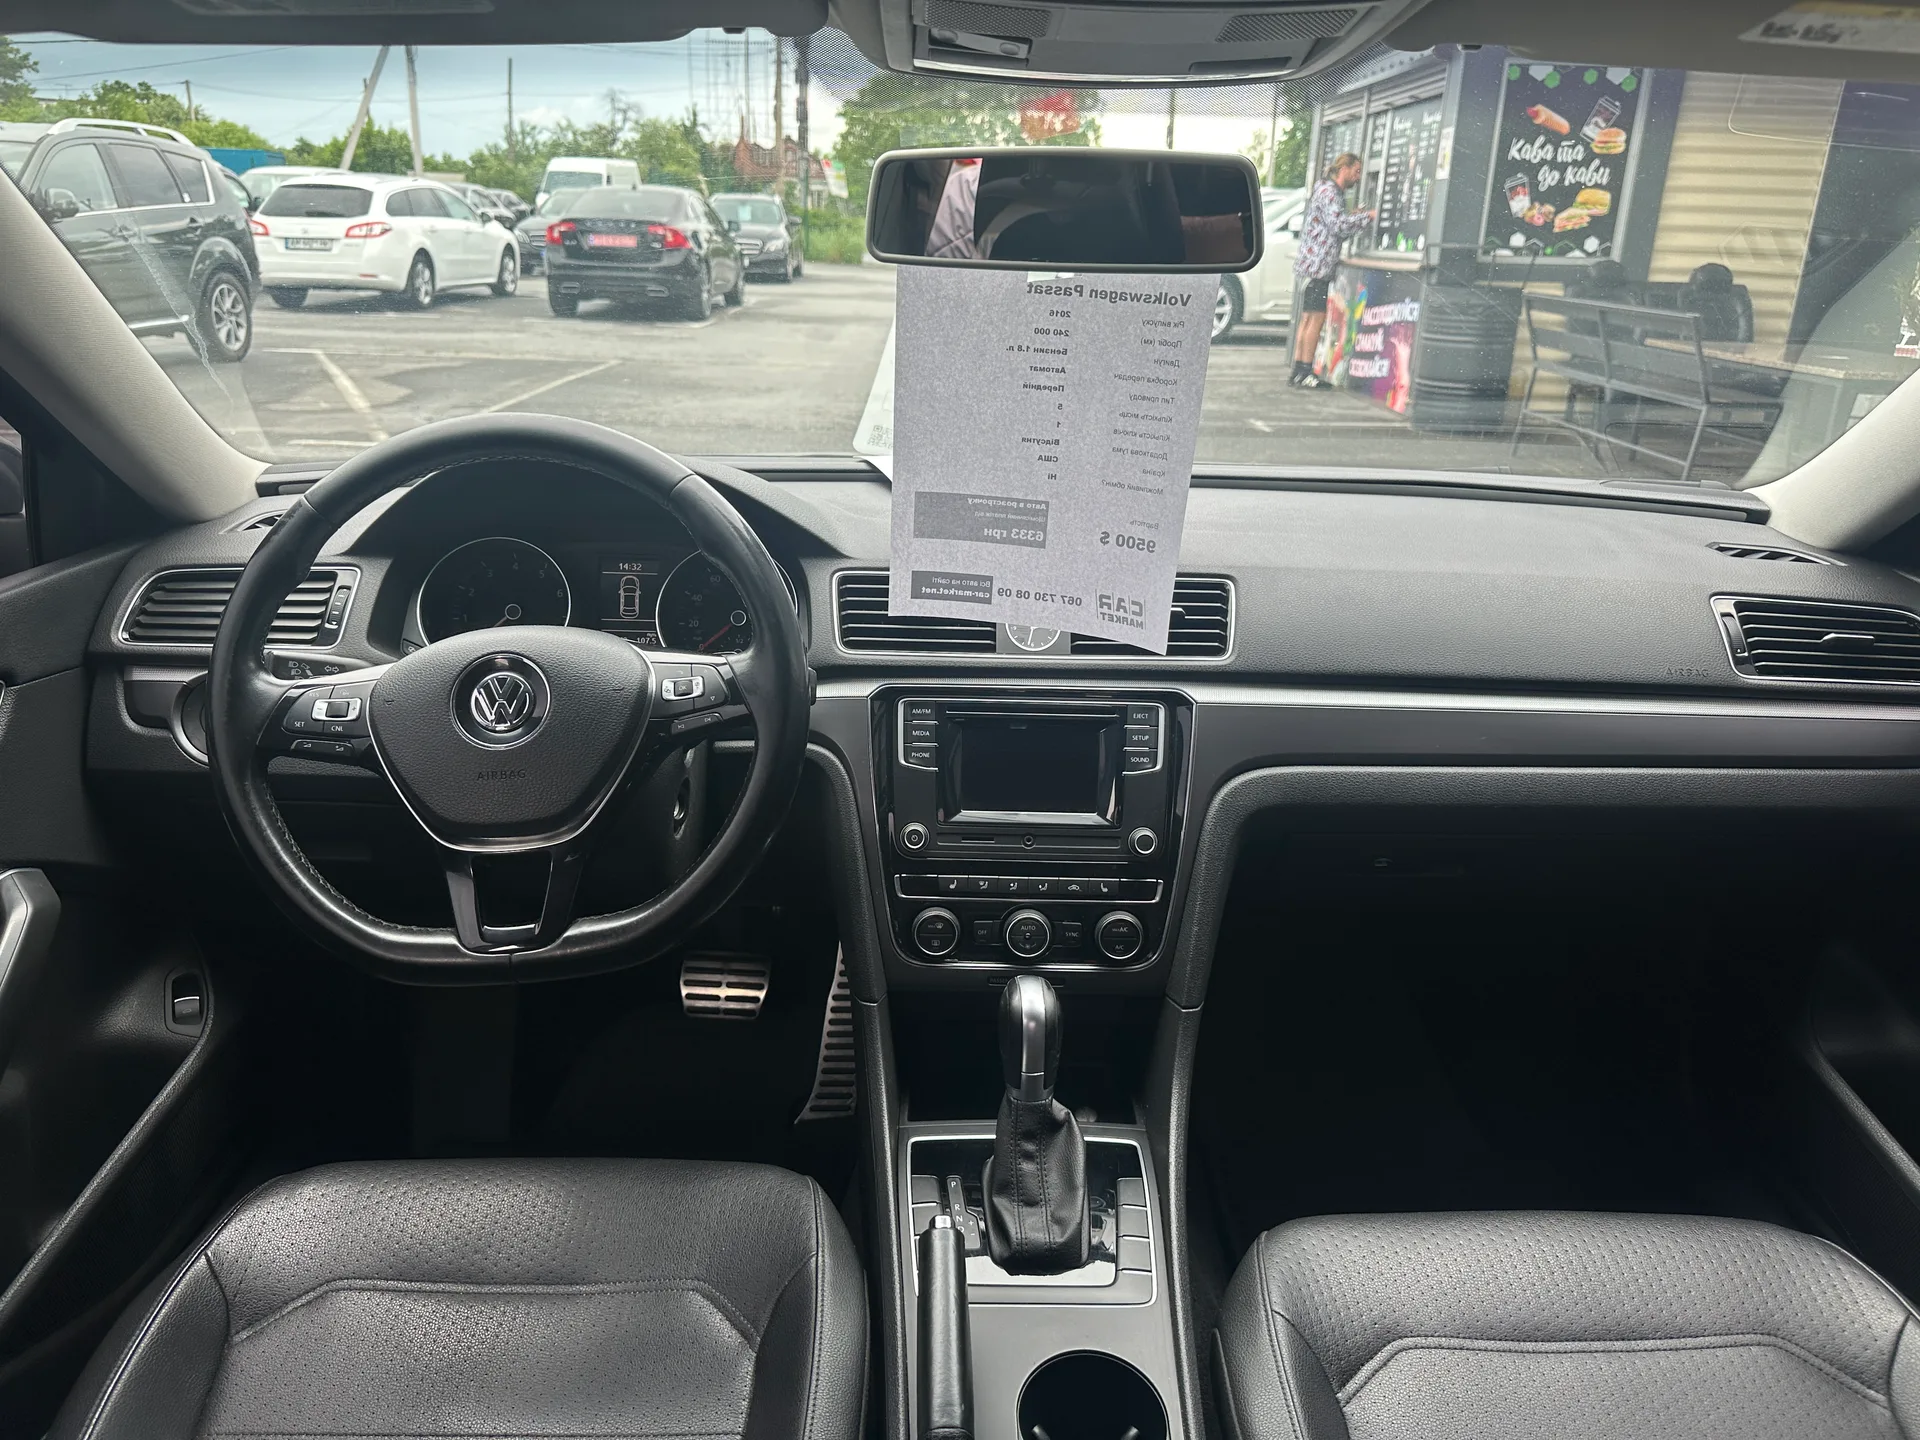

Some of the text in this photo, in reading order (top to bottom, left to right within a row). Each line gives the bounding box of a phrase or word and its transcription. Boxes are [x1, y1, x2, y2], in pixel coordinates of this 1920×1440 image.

[1508, 135, 1556, 163] Кава
[1564, 158, 1611, 186] кави
[619, 562, 642, 571] 14:32
[476, 770, 526, 780] AIRBAG
